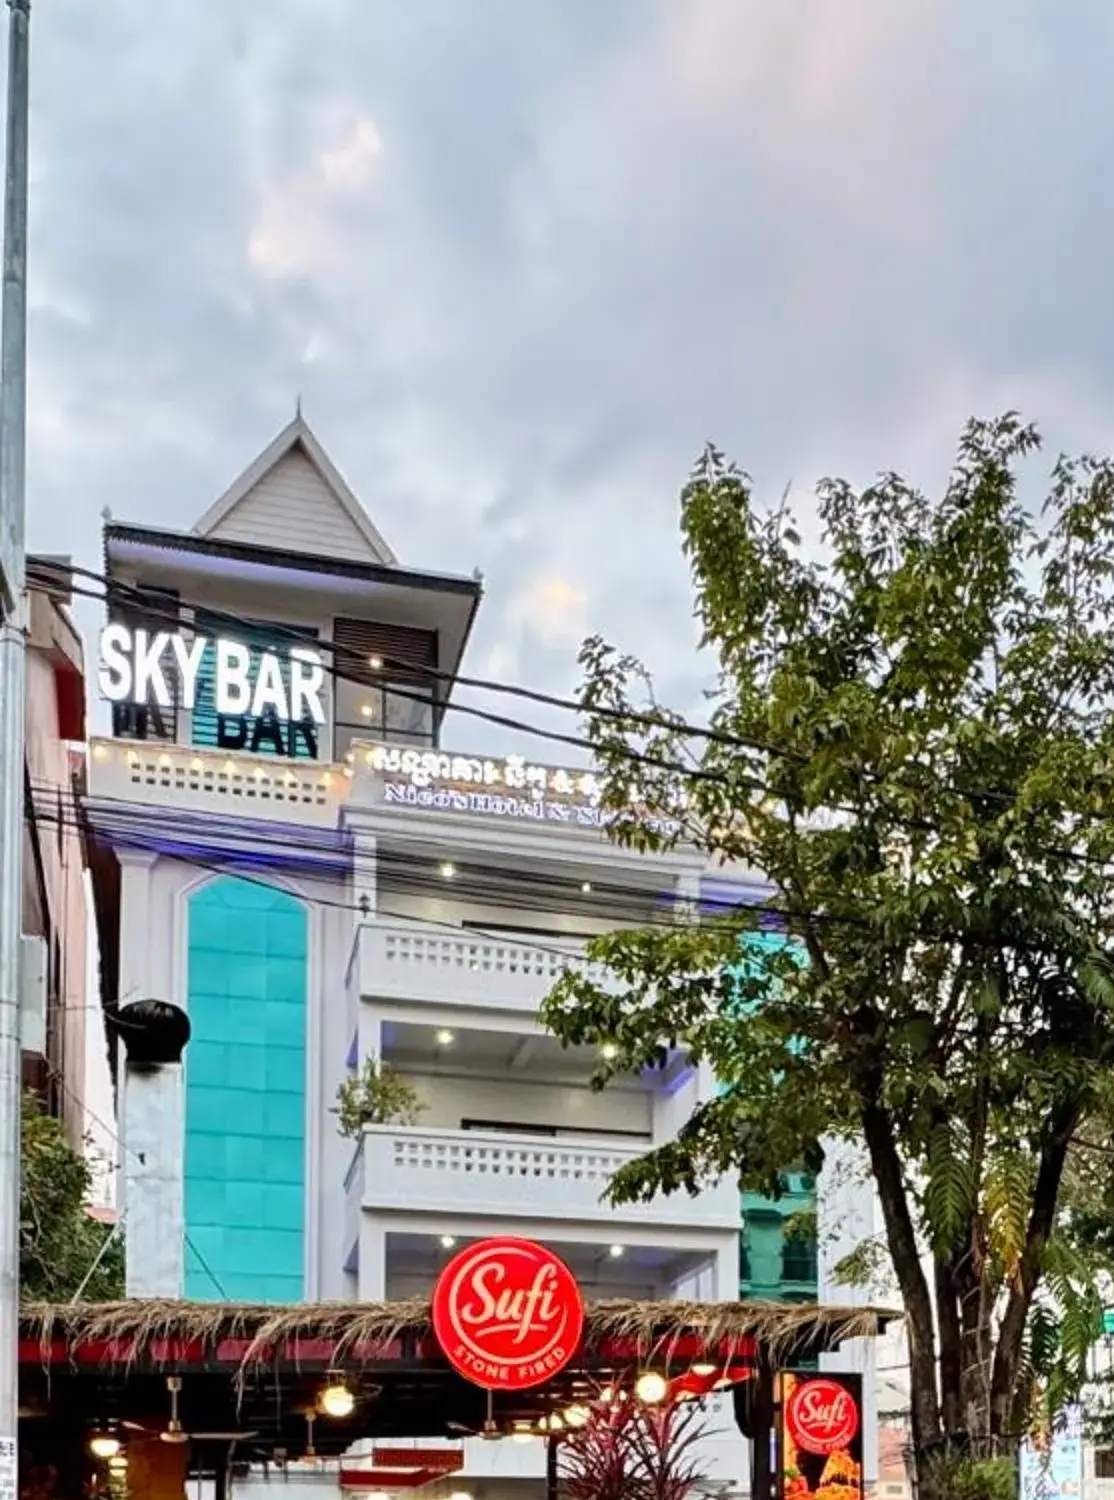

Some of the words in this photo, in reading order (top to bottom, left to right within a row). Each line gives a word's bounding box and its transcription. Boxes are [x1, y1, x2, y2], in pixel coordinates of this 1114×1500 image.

[100, 624, 206, 709] SKY
[217, 639, 327, 724] BAR
[461, 1262, 560, 1344] Sufi
[454, 1345, 509, 1380] STONE
[517, 1346, 566, 1379] FIRED
[799, 1390, 847, 1433] Sufi
